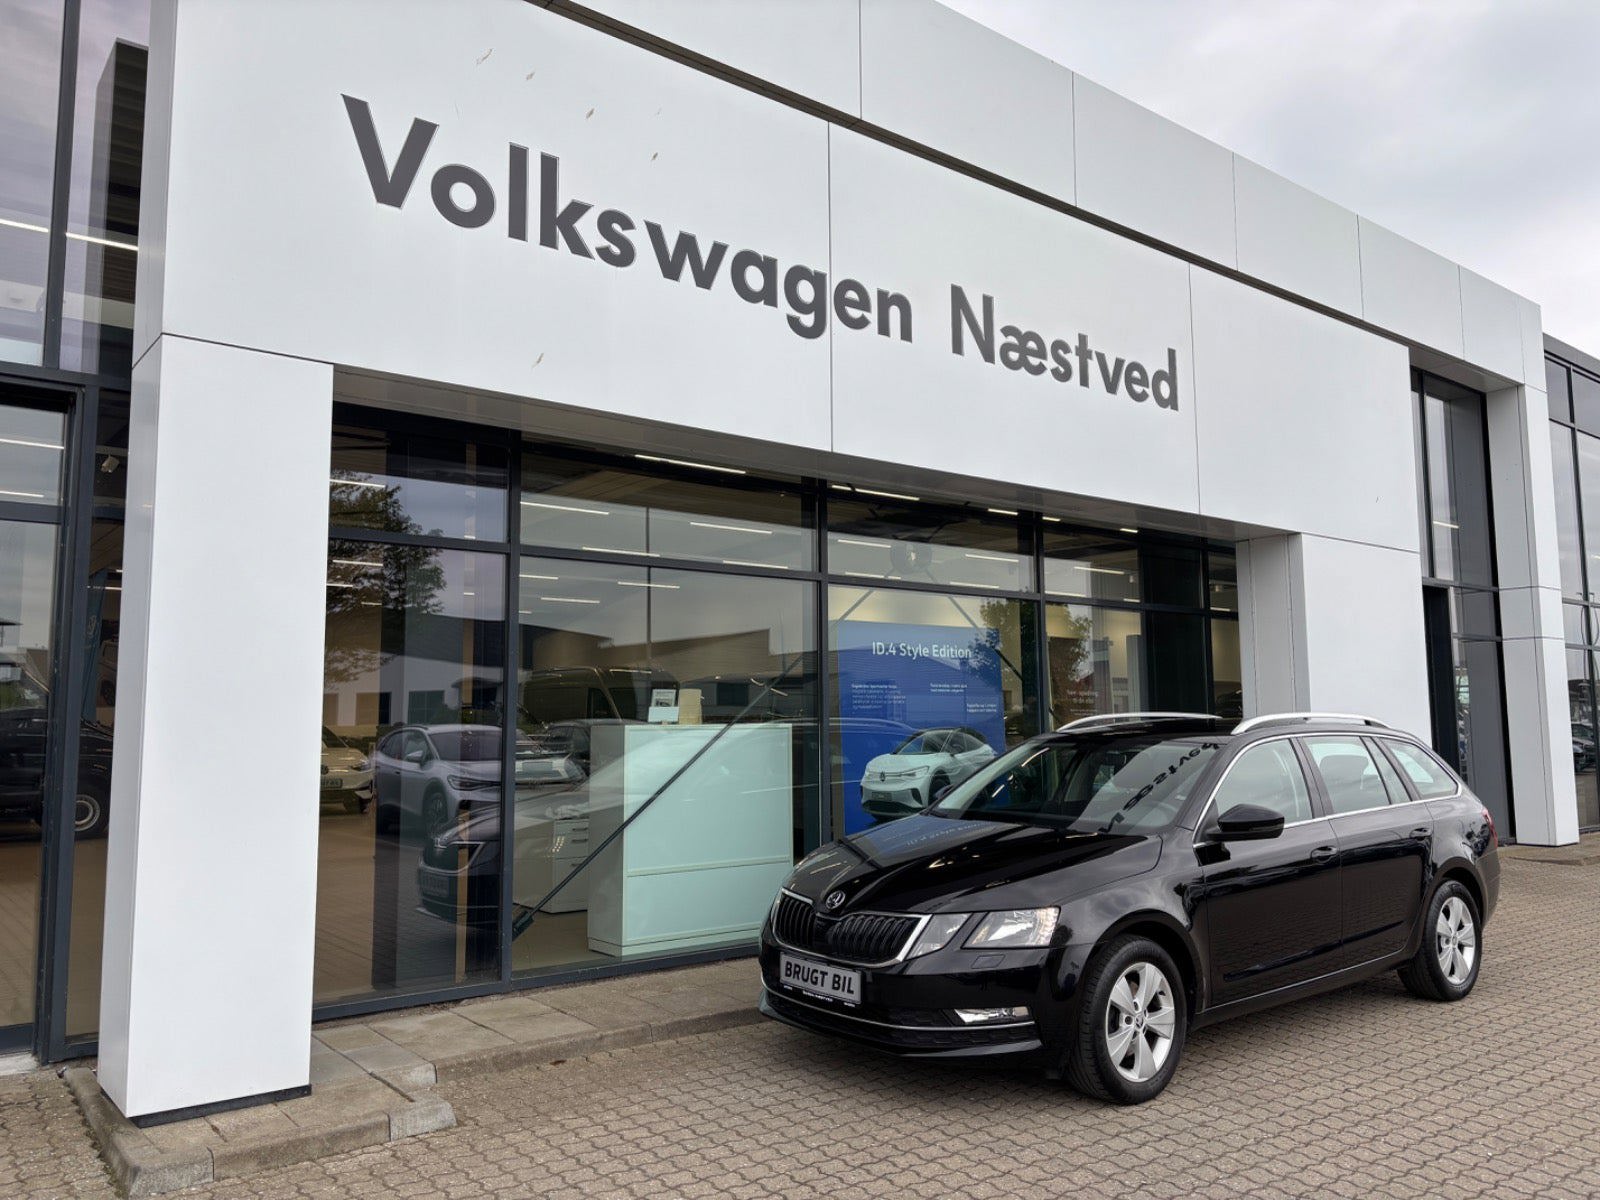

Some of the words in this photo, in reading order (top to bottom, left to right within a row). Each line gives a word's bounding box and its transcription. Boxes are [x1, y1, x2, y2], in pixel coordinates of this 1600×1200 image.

[340, 93, 913, 342] Volkswagen
[951, 283, 1179, 411] Næstved
[872, 641, 896, 656] ID.4
[900, 642, 929, 660] Style
[932, 645, 972, 658] Edition
[784, 961, 828, 987] BRUGT
[832, 973, 855, 995] BIL
